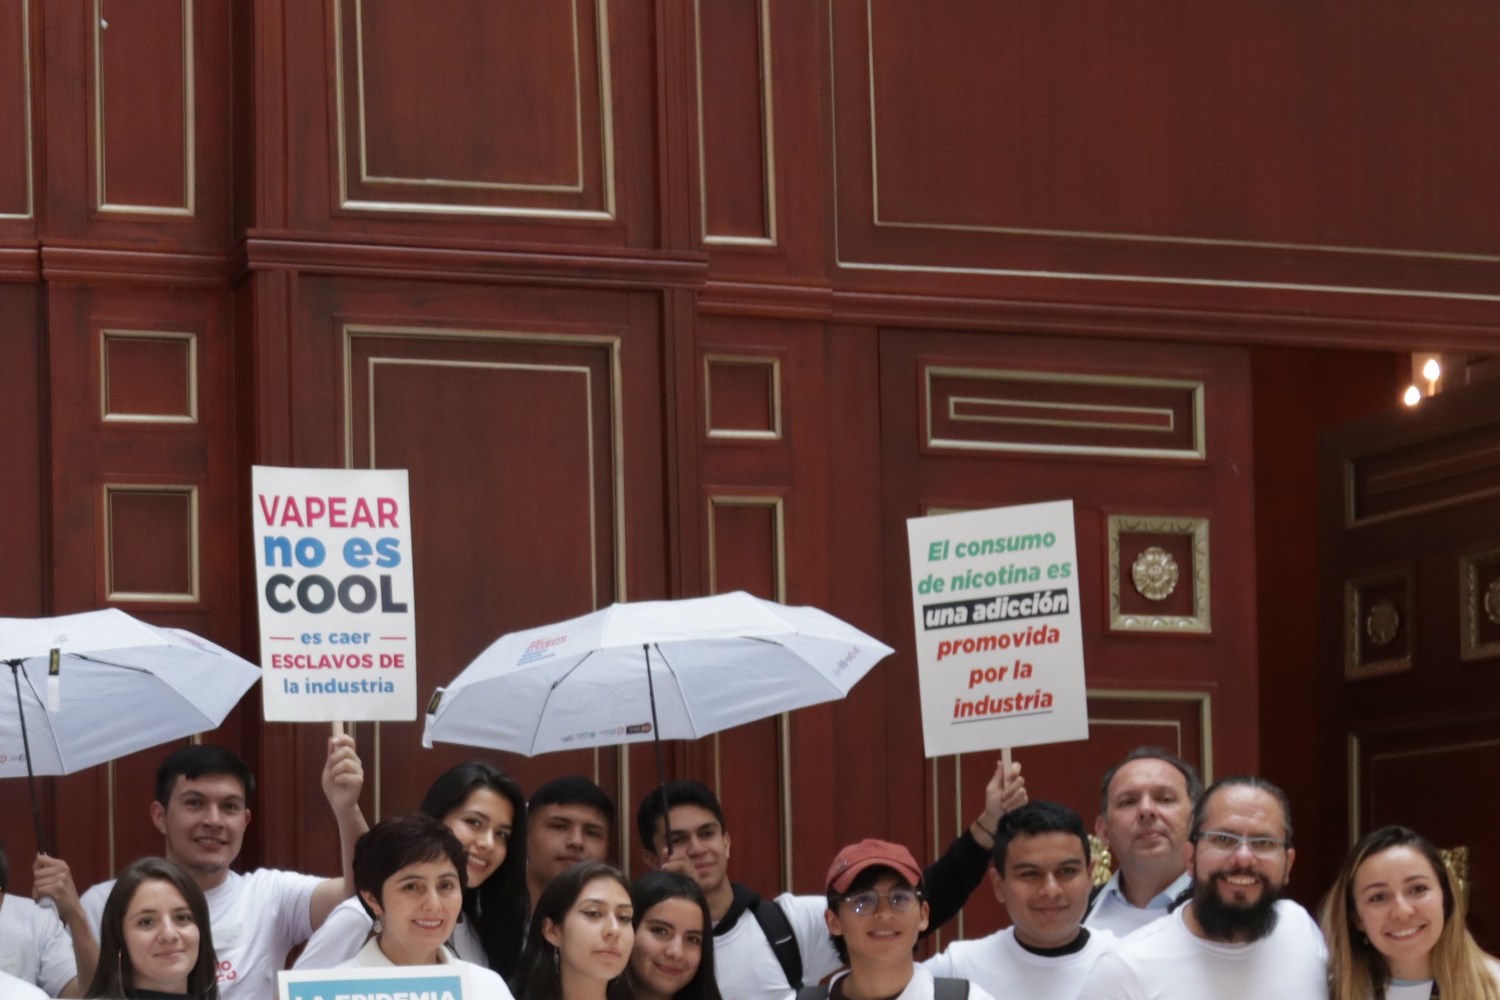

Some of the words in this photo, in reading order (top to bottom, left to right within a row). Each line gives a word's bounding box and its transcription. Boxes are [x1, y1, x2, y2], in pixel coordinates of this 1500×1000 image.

[259, 494, 399, 528] VAPEAR
[264, 536, 326, 568] no
[343, 537, 401, 568] es
[928, 540, 949, 562] El
[955, 532, 1056, 558] consumo
[265, 574, 408, 614] COOL
[918, 574, 945, 595] de
[951, 564, 1040, 592] nicotina
[1047, 562, 1072, 578] es
[925, 605, 968, 628] una
[973, 591, 1068, 622] adicción
[301, 633, 322, 644] es
[329, 632, 371, 644] caer
[937, 625, 1060, 661] promovida
[272, 654, 373, 669] ESCLAVOS
[380, 654, 404, 669] DE
[969, 666, 1008, 689] por
[1013, 660, 1032, 679] la
[284, 679, 299, 694] la
[305, 678, 394, 694] industria
[953, 690, 1053, 718] industria
